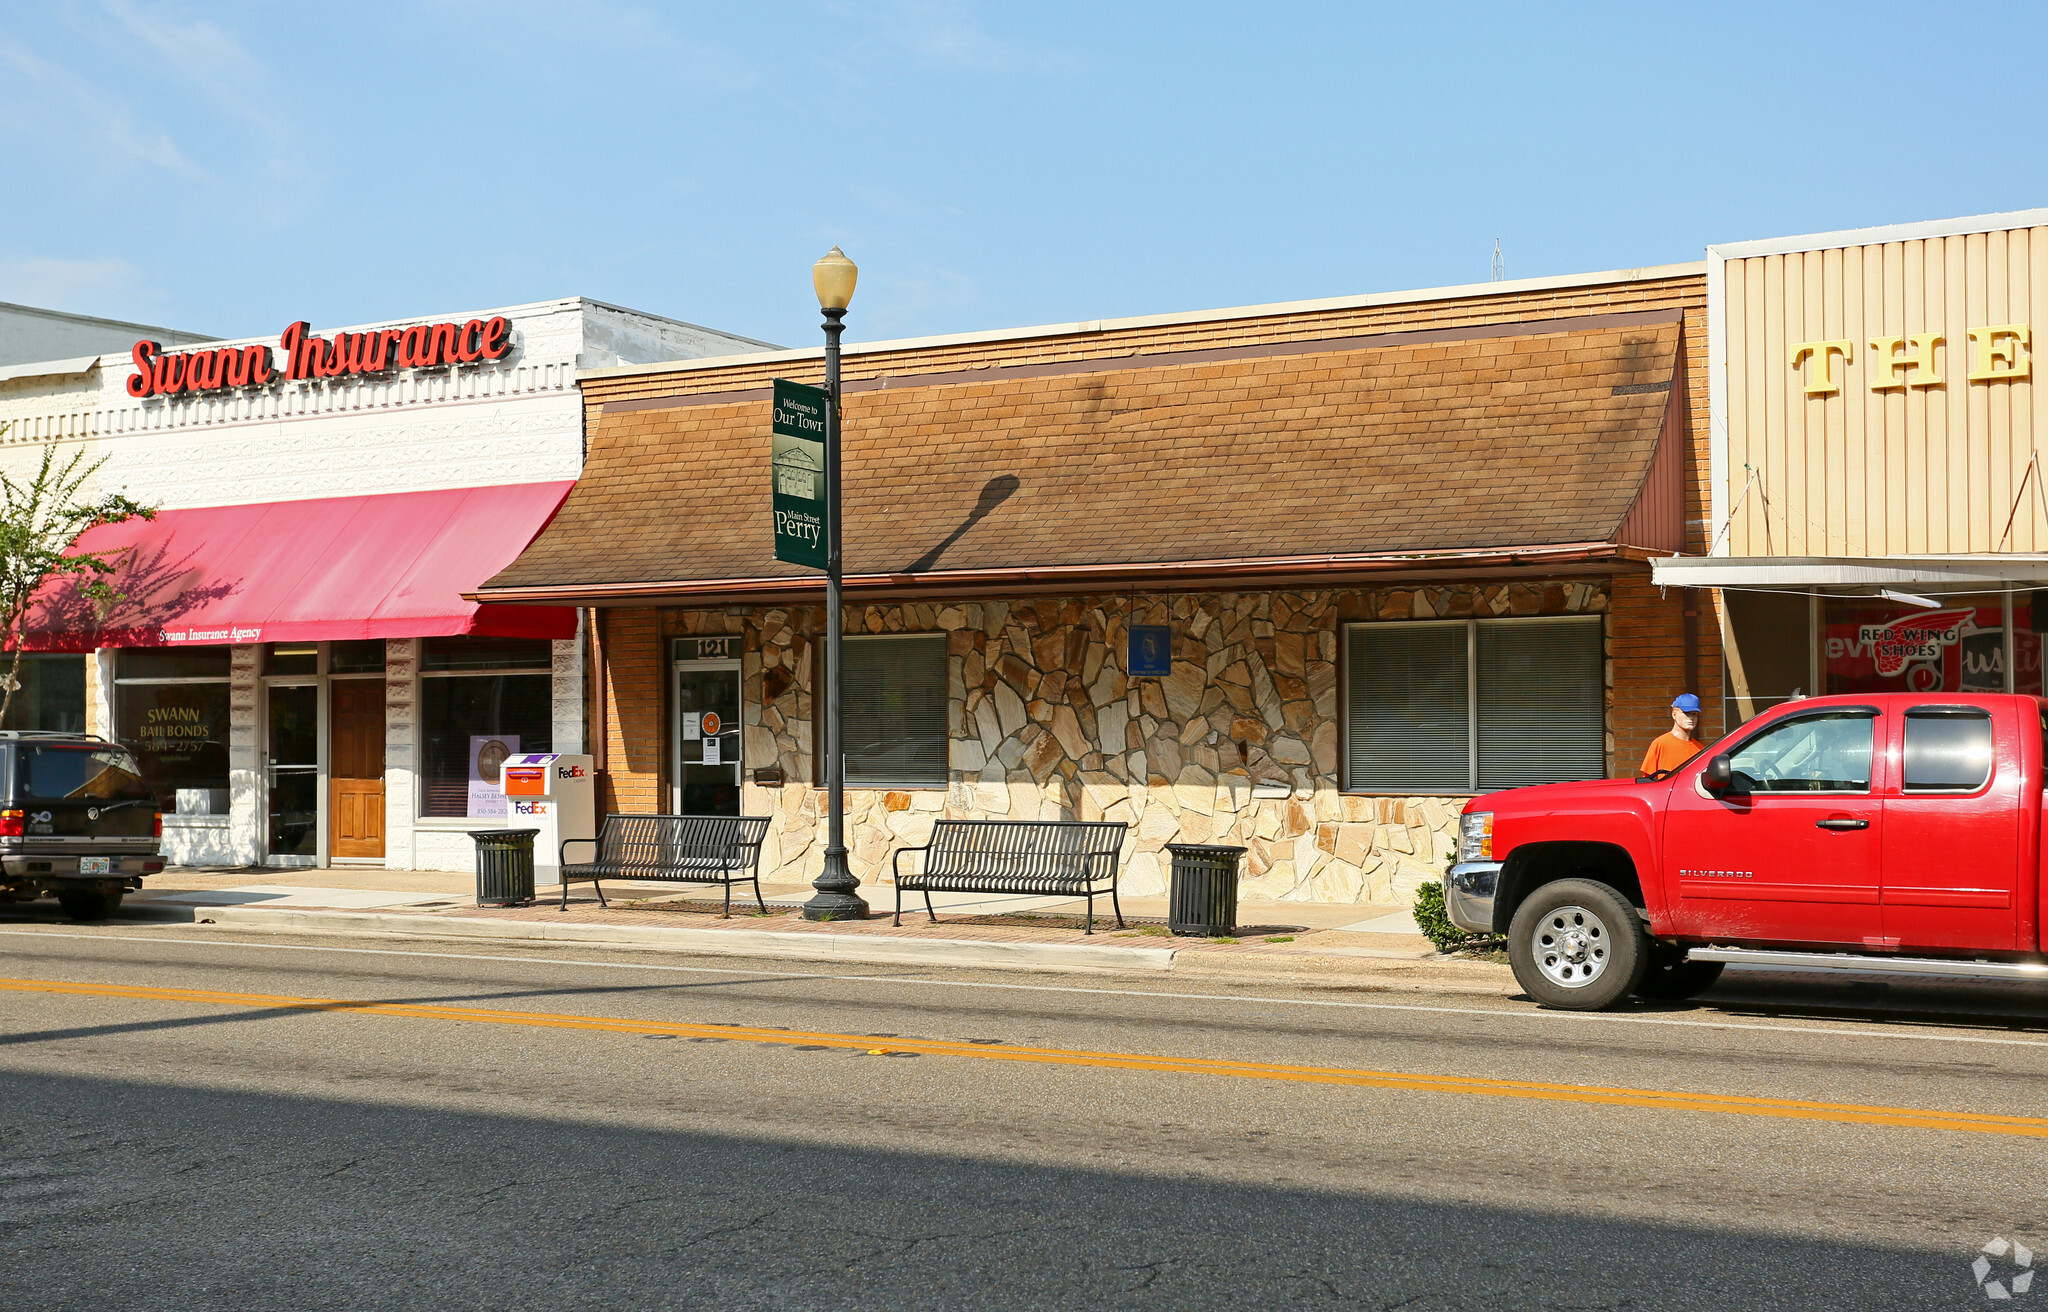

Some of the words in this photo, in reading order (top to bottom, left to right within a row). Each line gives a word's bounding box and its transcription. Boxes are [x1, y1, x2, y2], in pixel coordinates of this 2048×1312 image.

[126, 339, 277, 398] Swann
[281, 316, 513, 381] Insurance
[1789, 323, 2031, 394] THE
[783, 397, 810, 414] Welcome
[811, 405, 818, 415] to
[773, 407, 795, 426] Our
[787, 509, 803, 521] Main
[803, 512, 820, 525] Street
[774, 510, 821, 549] Perry
[158, 629, 187, 642] Swann
[188, 628, 229, 641] Insurance
[229, 626, 262, 642] Agency
[1861, 629, 1894, 641] RED
[1903, 629, 1956, 641] WING
[698, 640, 728, 658] 121
[1881, 644, 1936, 657] SHOES
[147, 707, 200, 723] SWANN
[140, 725, 165, 737] BAIL
[167, 725, 209, 737] BONDS
[145, 741, 205, 752] 584-2757
[558, 765, 585, 779] FedEx
[515, 801, 547, 815] FedEx
[1679, 869, 1754, 878] SILVERADO
